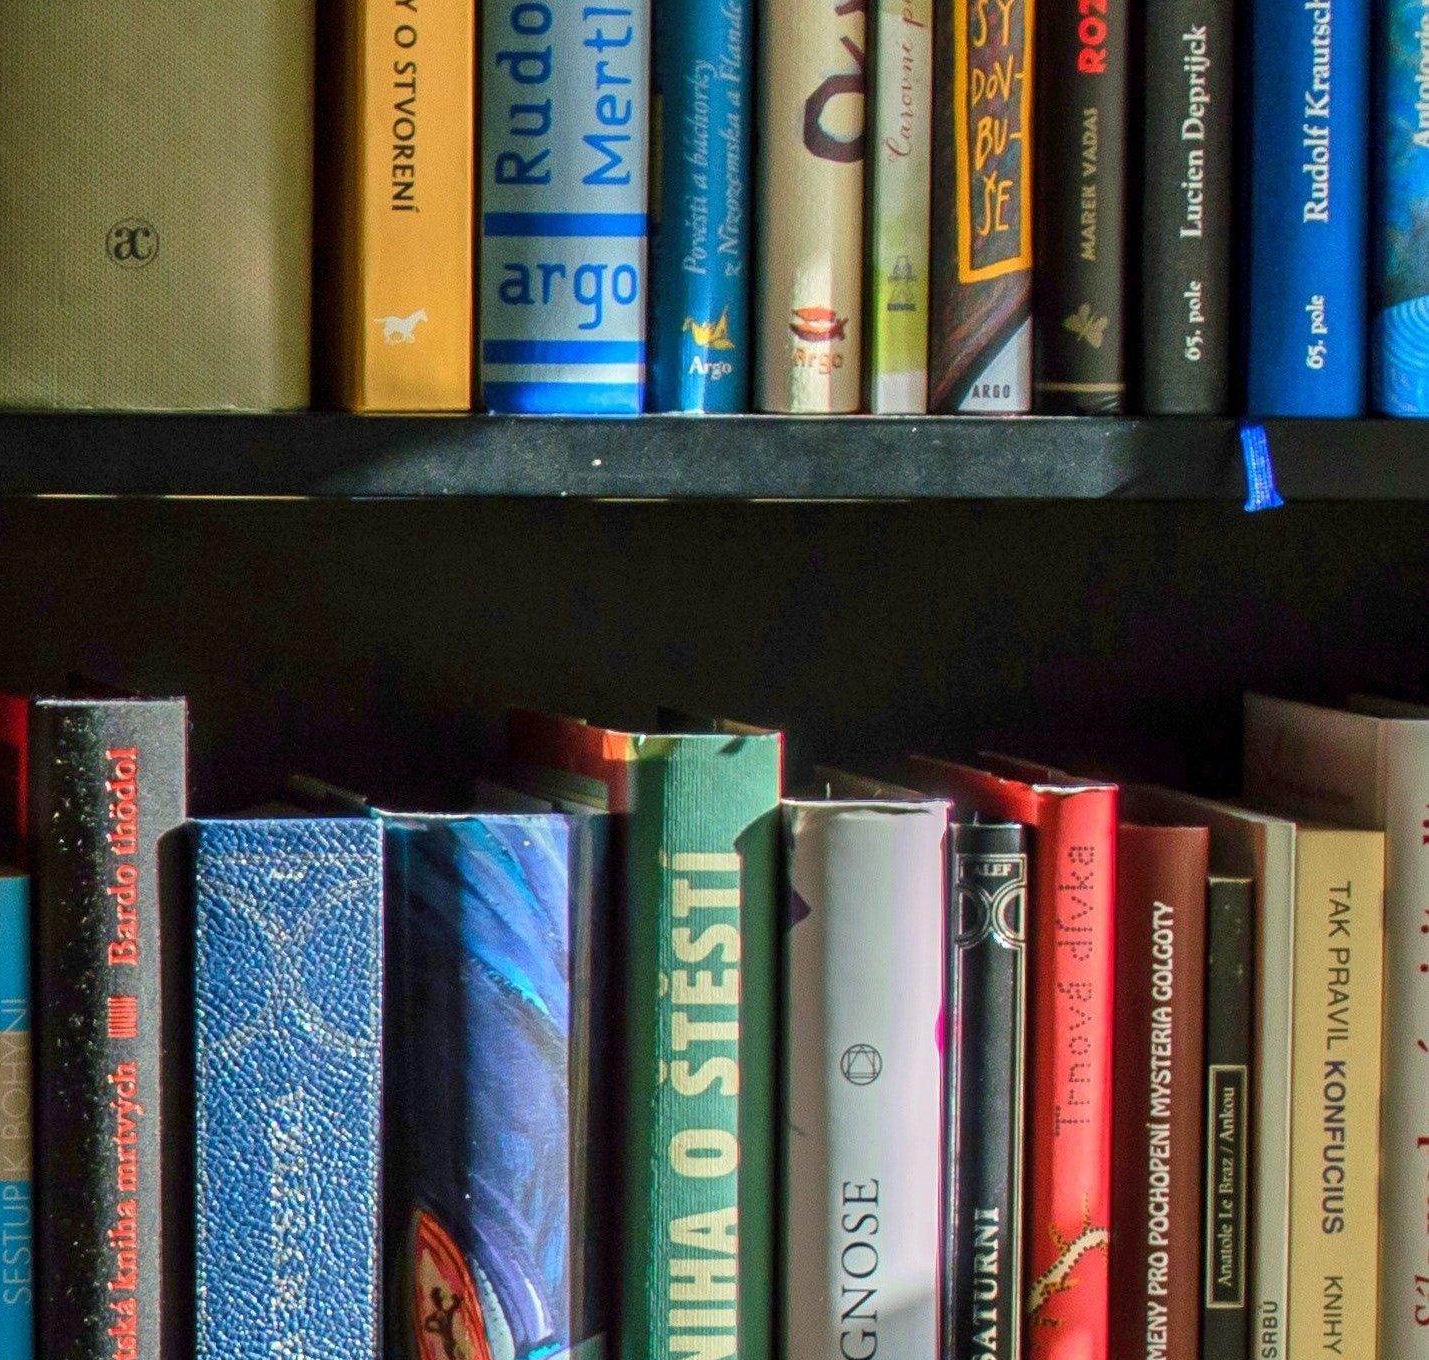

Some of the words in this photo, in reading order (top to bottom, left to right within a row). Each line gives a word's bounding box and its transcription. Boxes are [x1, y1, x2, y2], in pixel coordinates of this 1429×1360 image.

[1181, 25, 1210, 140] Deprijck
[1179, 149, 1204, 238] Lucien
[498, 263, 639, 330] argo
[1184, 280, 1204, 322] pole
[688, 356, 733, 379] Argo
[1185, 330, 1204, 361] 65.
[972, 384, 1011, 399] ARGO
[1328, 880, 1352, 938] TAK
[657, 852, 740, 1096] ŠTĚSTÍ
[1327, 947, 1352, 1050] PRAVIL
[668, 1128, 740, 1177] O
[1322, 1060, 1347, 1235] KONFUCIUS
